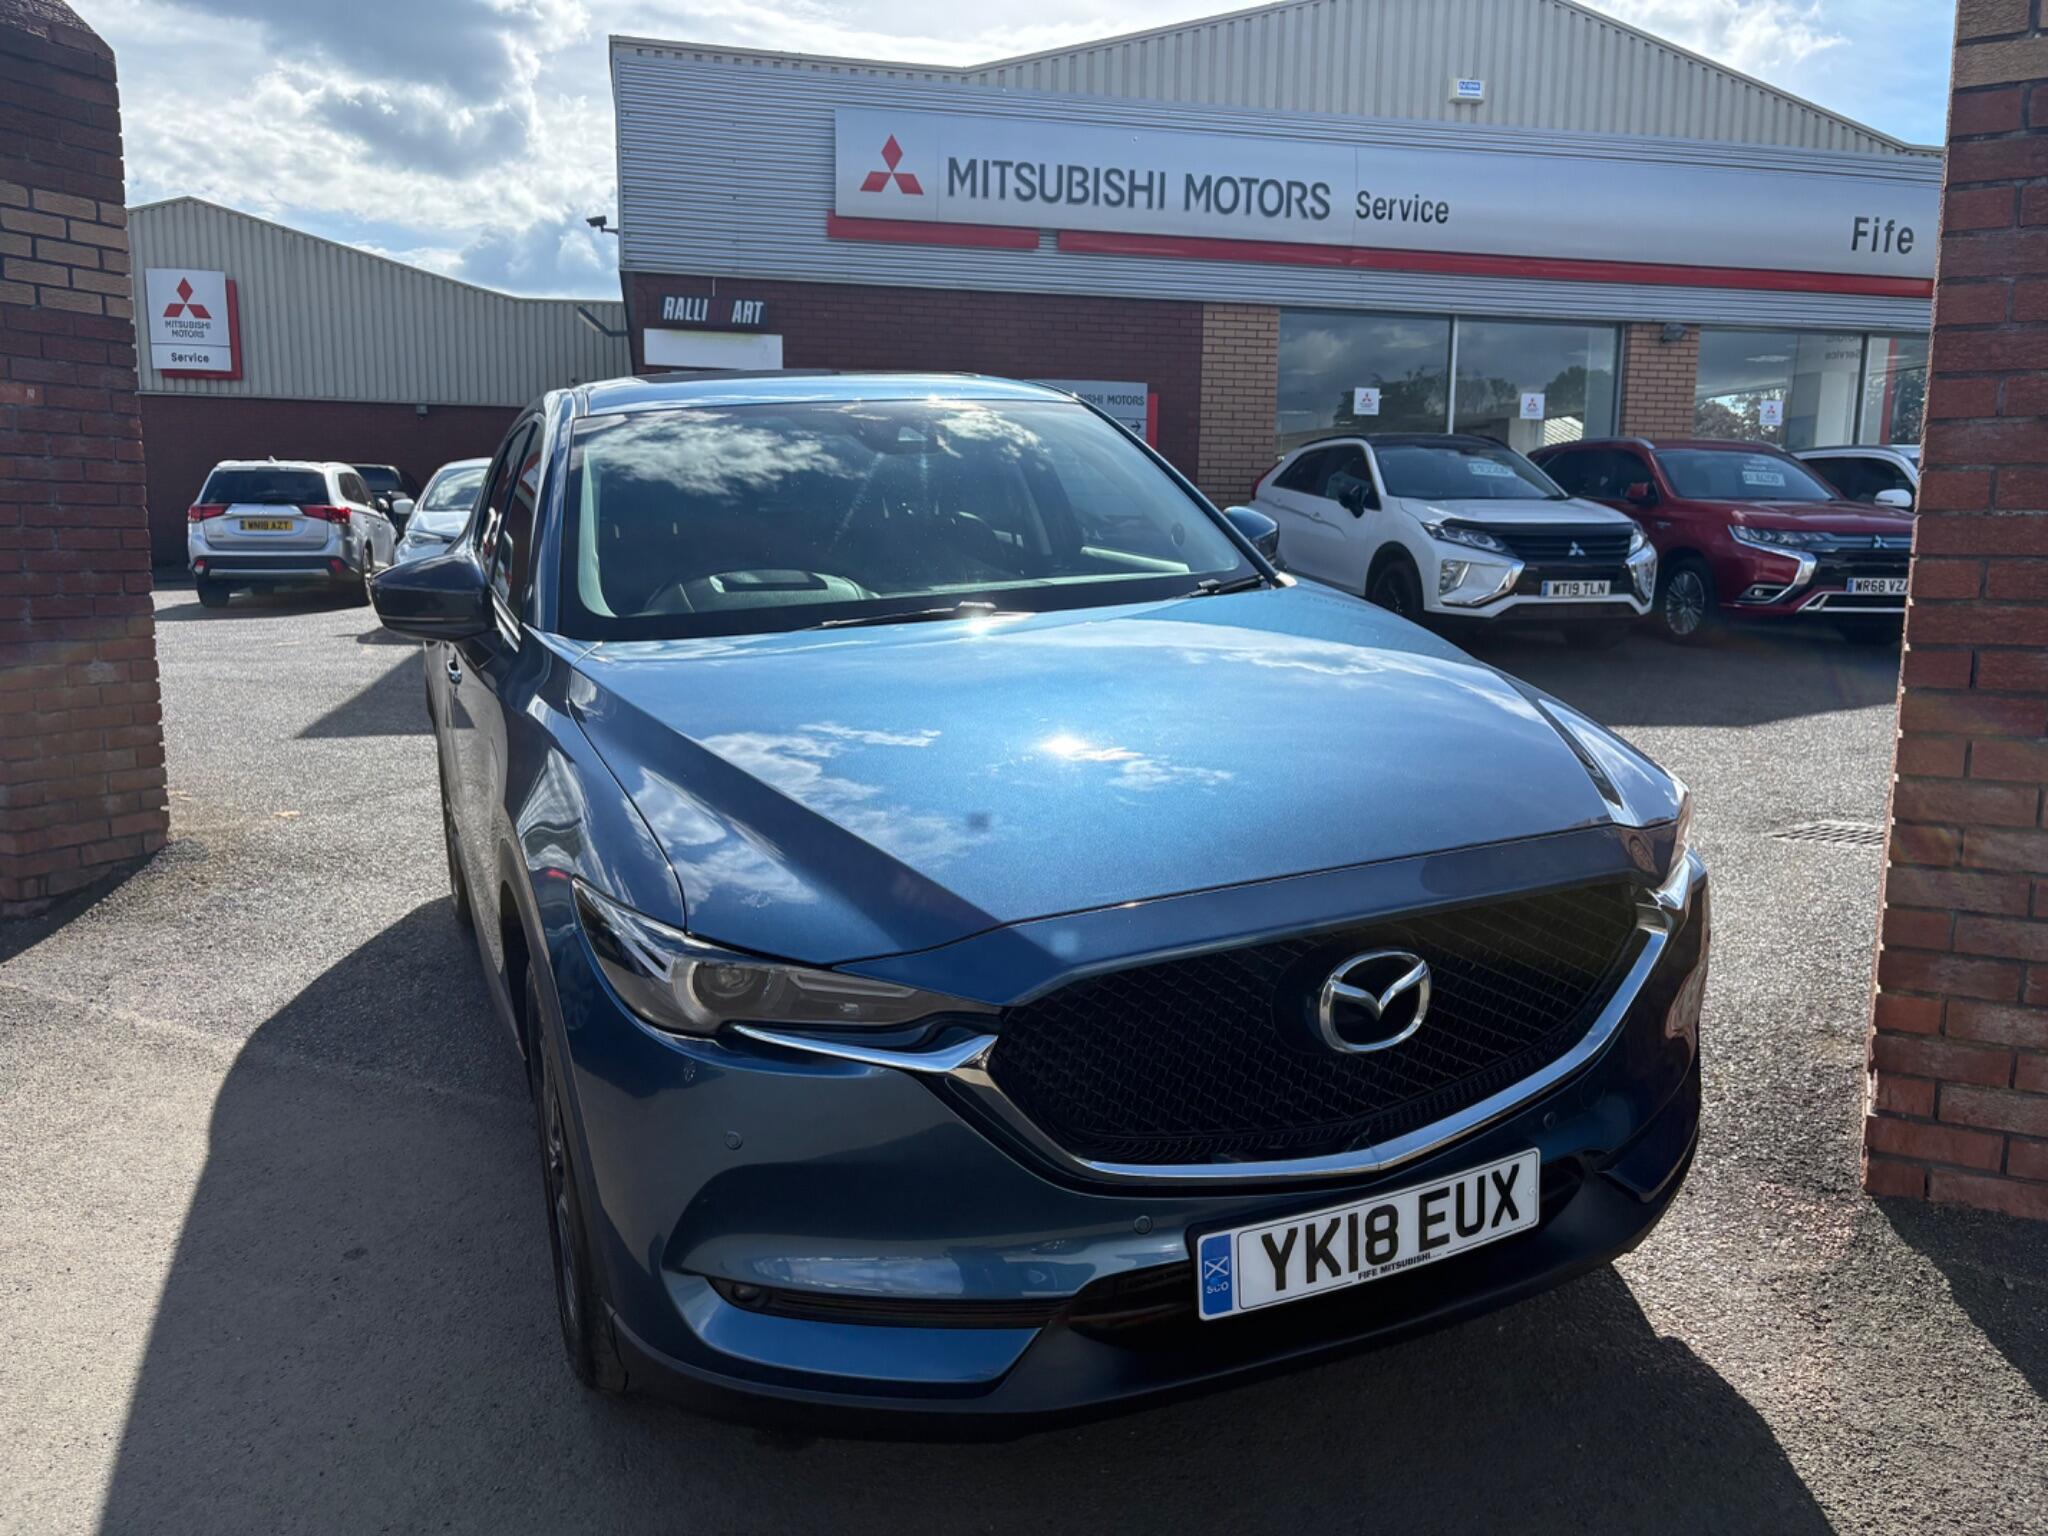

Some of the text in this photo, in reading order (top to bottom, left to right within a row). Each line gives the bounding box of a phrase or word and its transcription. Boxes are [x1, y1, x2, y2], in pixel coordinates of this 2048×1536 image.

[948, 157, 1449, 224] MITSUBISHI MOTORS Service
[1851, 216, 1914, 255] Fife
[663, 296, 764, 325] RALLI ART
[164, 320, 211, 330] MITSUBISHI
[171, 329, 205, 339] MOTORS
[171, 352, 210, 363] Service
[1107, 395, 1145, 406] MOTORS
[1552, 582, 1606, 595] WT19 TLN
[1856, 580, 1886, 592] WR68
[1261, 1163, 1520, 1291] YK18 EUX
[1358, 1252, 1431, 1280] FIFE MITSUBISHI
